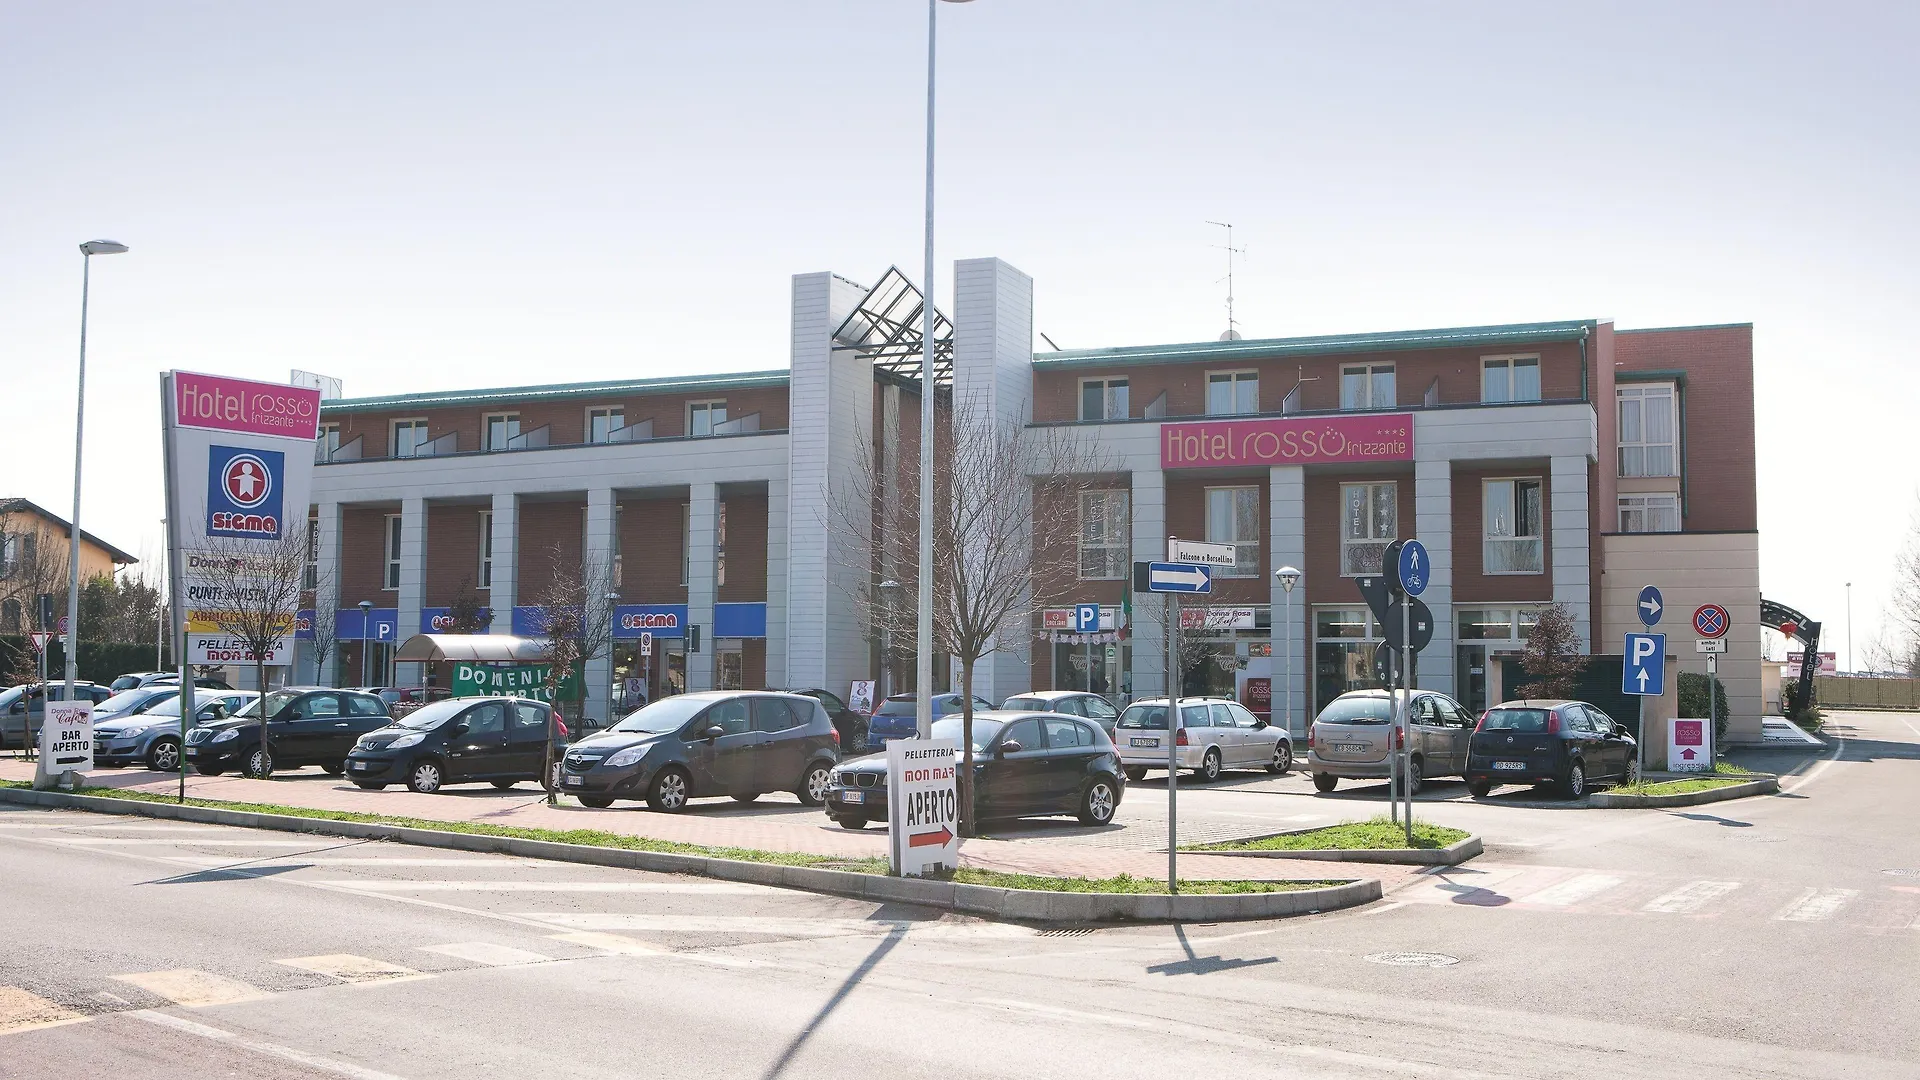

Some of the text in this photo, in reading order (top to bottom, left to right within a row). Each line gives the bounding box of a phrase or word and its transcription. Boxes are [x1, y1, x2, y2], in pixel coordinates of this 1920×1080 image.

[182, 383, 312, 423] Hotel rosso
[252, 411, 294, 427] frizzante
[1168, 426, 1406, 462] Hotel rosso frizzante
[1180, 551, 1200, 561] Falcone
[1206, 553, 1233, 564] Borsellino
[1080, 607, 1095, 629] P
[1232, 609, 1251, 617] Rosa
[379, 623, 390, 639] P
[198, 639, 284, 651] PELLETIA
[1633, 637, 1656, 666] P
[244, 650, 275, 661] MR
[857, 681, 868, 696] 8
[62, 730, 81, 740] BAR
[52, 740, 89, 752] APERTO
[904, 747, 955, 760] PELLETTERIA
[905, 766, 955, 782] MON MAR
[906, 787, 955, 827] APERTO
